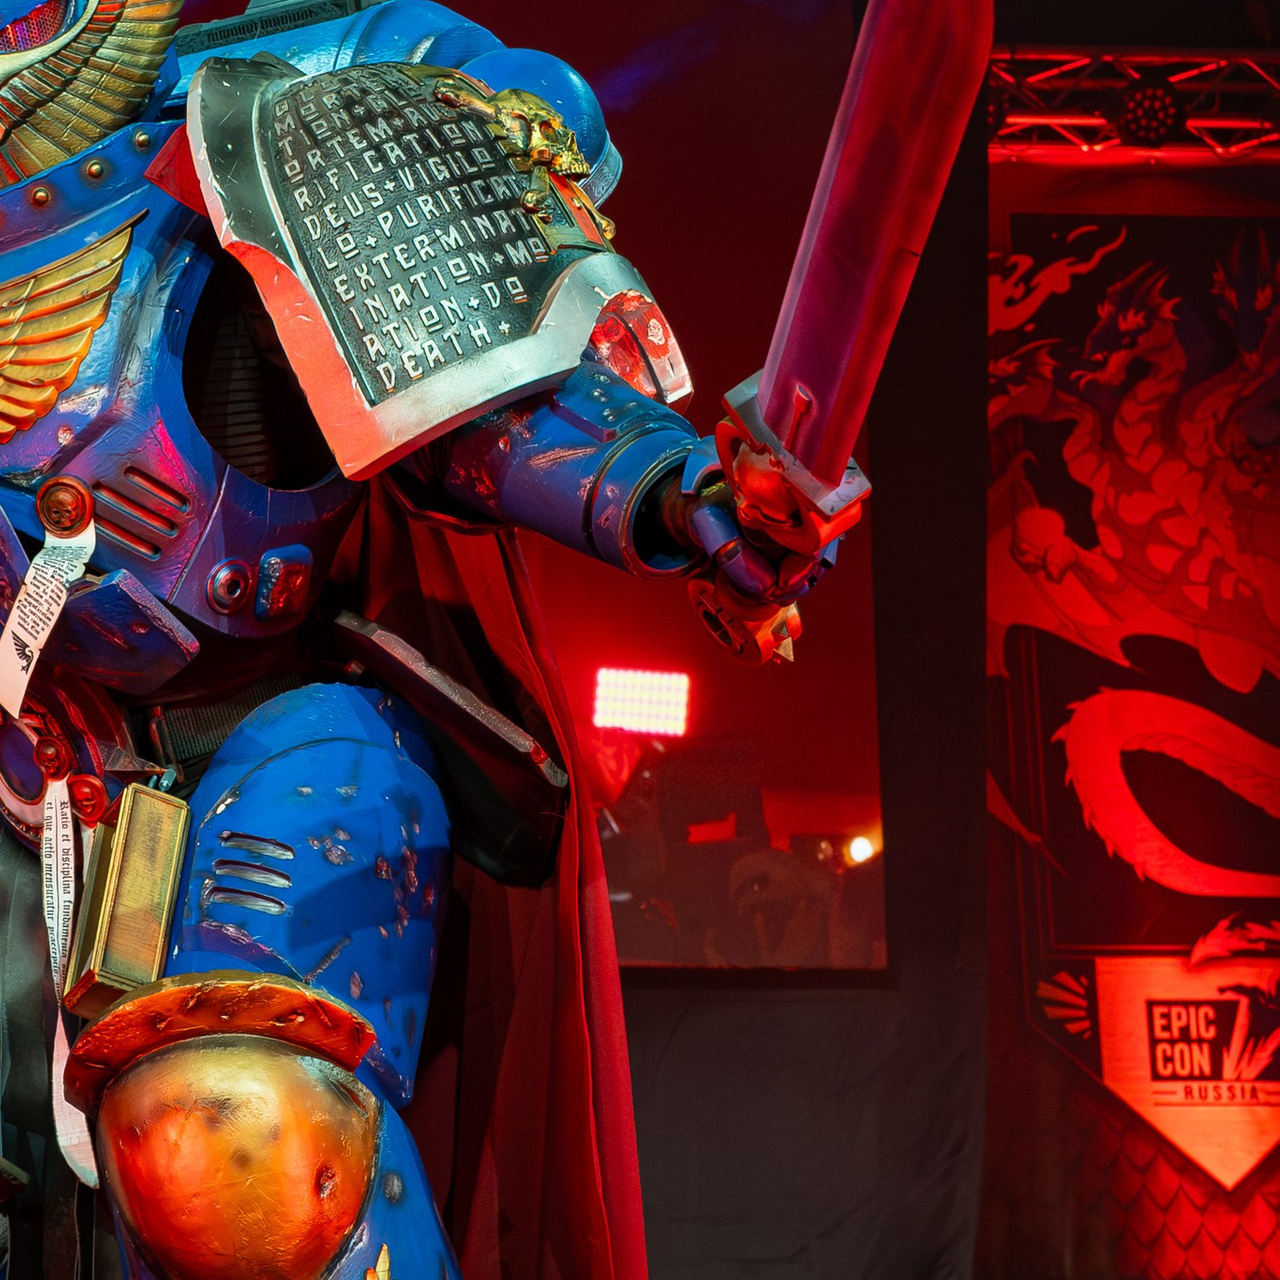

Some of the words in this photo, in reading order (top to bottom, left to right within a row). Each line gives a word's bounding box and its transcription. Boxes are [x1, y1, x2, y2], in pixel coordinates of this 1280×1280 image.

[1152, 1004, 1217, 1040] EPIC
[1155, 1041, 1212, 1078] CON
[1184, 1085, 1260, 1102] RUSSIA
